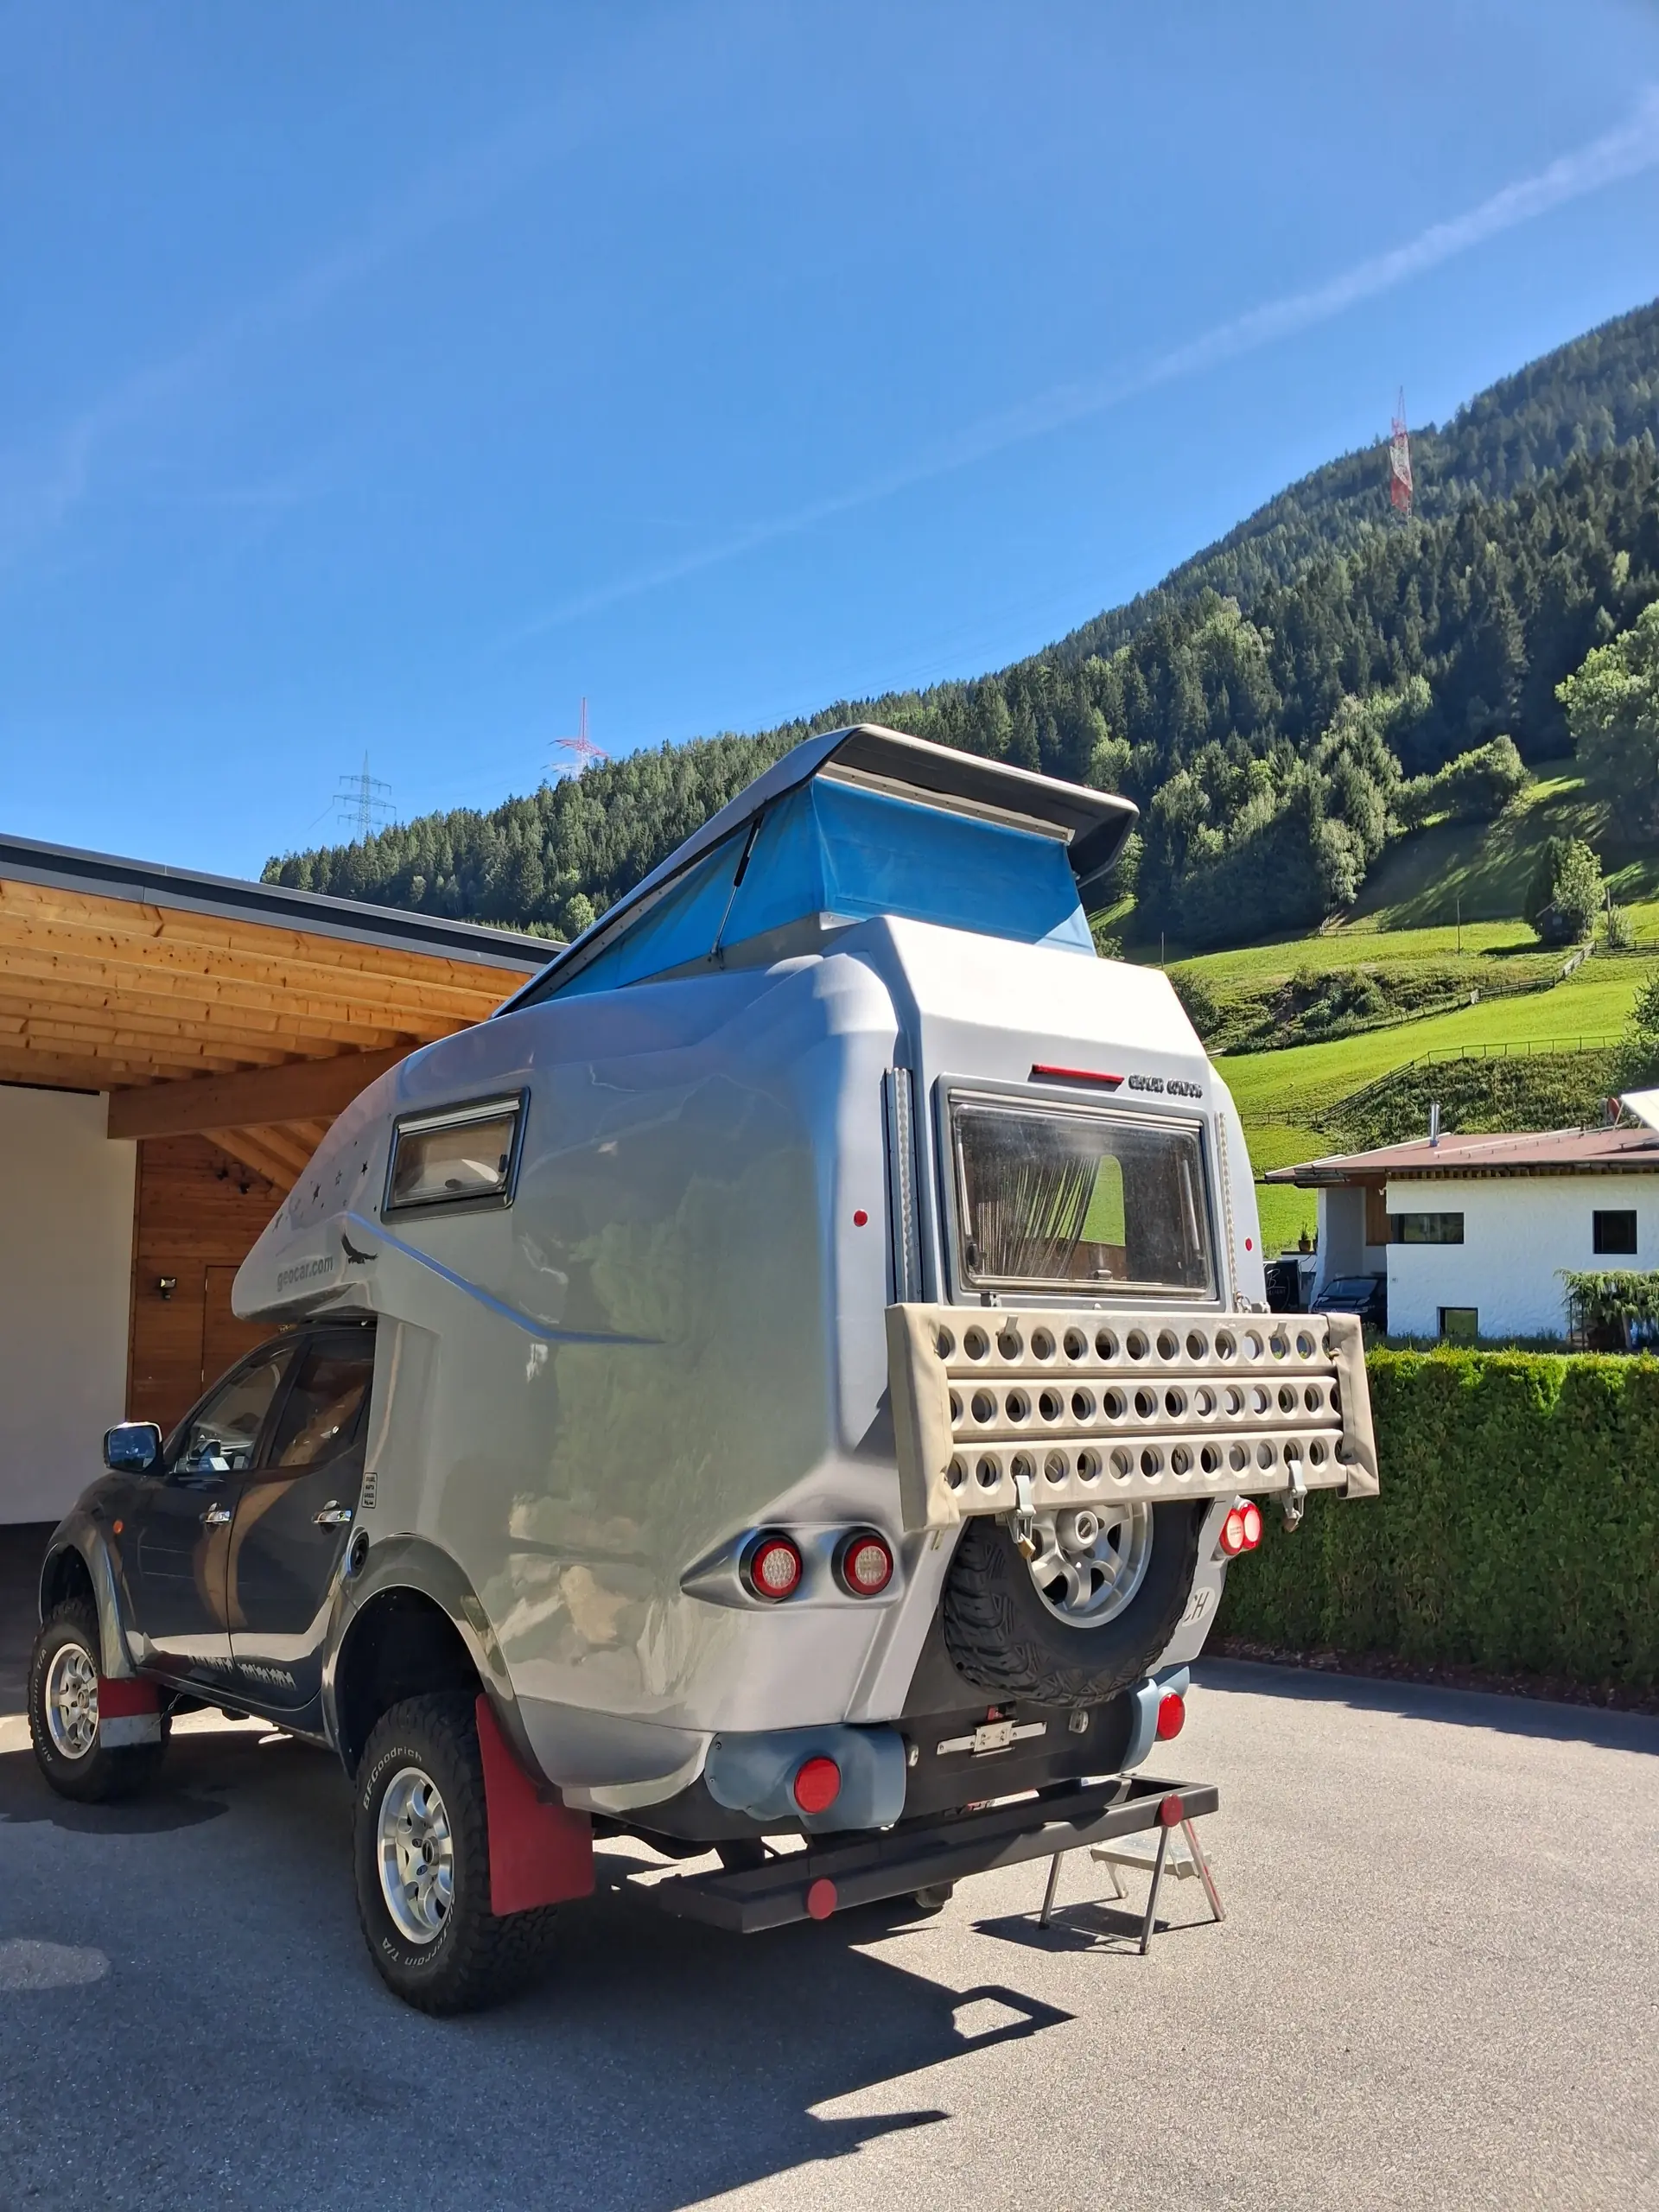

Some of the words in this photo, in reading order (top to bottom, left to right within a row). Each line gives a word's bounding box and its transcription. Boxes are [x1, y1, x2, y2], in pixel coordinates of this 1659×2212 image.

[277, 1256, 334, 1293] geocar.com
[363, 1746, 423, 1811] BFGoodrich
[382, 1937, 399, 1962] T/A
